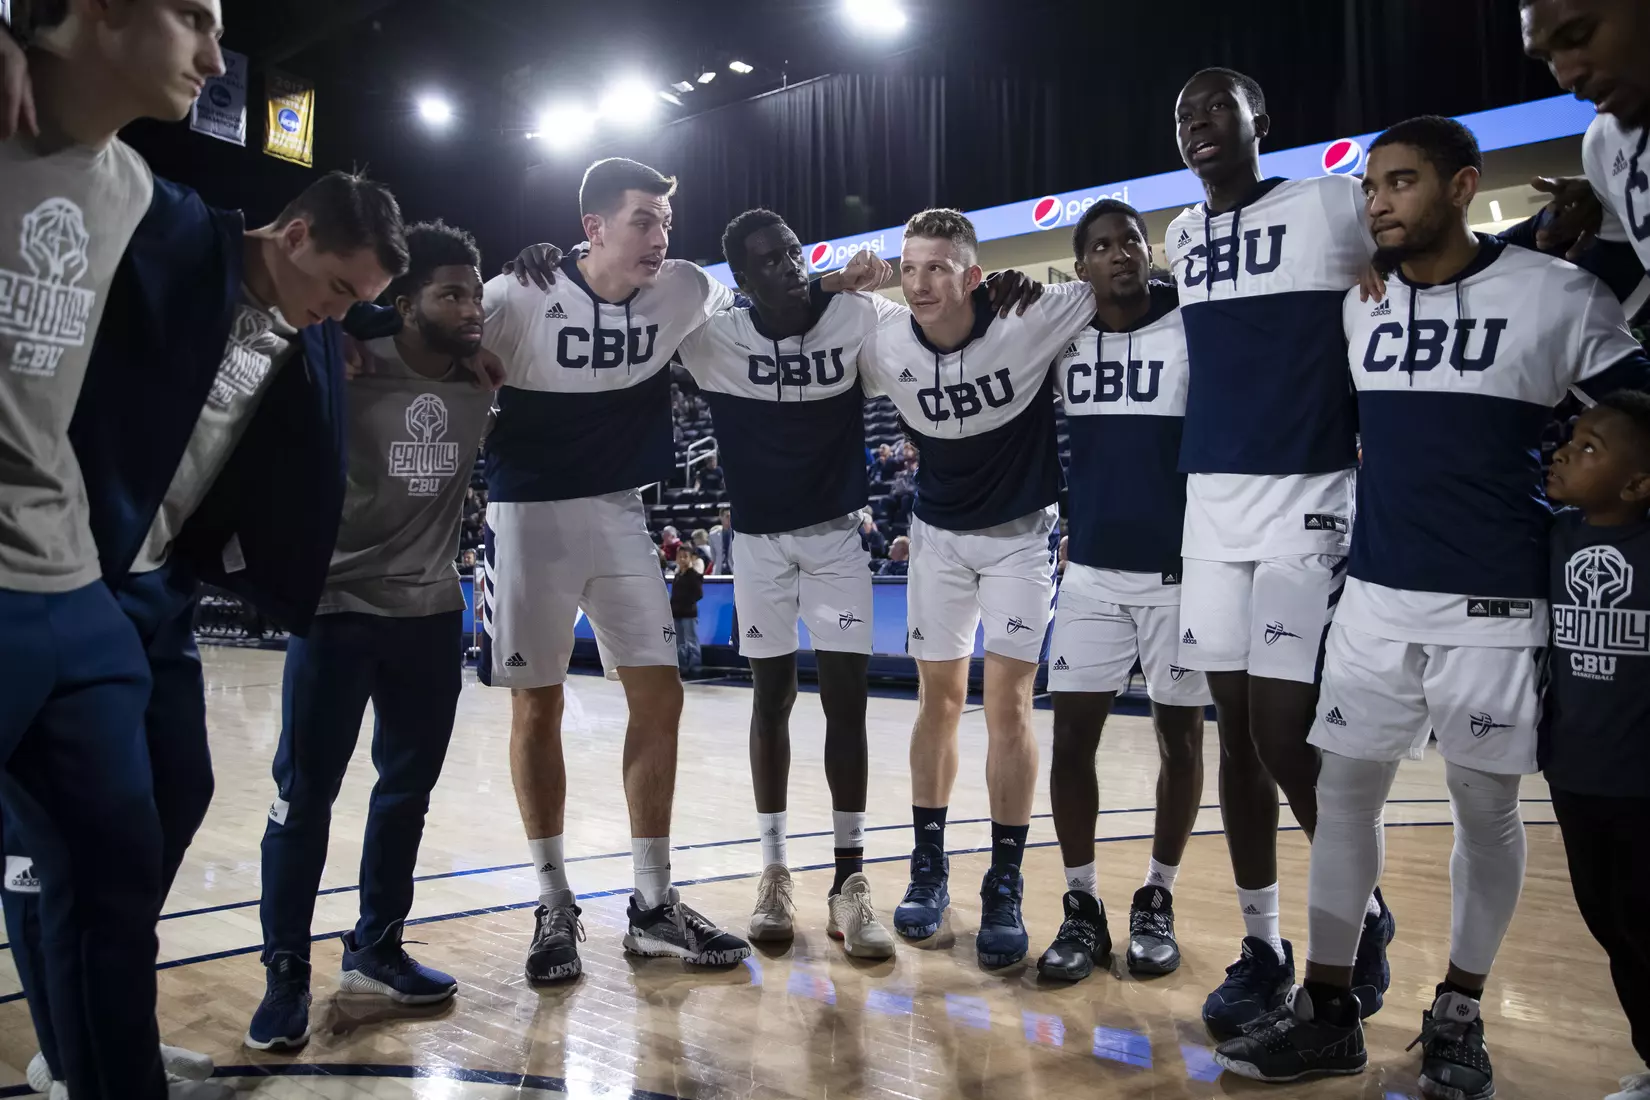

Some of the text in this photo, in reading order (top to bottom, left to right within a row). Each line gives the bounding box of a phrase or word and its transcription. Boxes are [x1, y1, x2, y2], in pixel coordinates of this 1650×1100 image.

[1183, 224, 1286, 288] CBU
[545, 312, 568, 320] adidas
[1371, 309, 1392, 317] adidas
[12, 341, 64, 371] CBU
[556, 324, 658, 369] CBU
[1361, 318, 1508, 373] CBU
[747, 347, 844, 386] CBU
[916, 367, 1014, 422] CBU
[1067, 360, 1164, 404] CBU
[407, 478, 440, 493] CBU
[1570, 652, 1617, 675] CBU
[1572, 670, 1615, 681] BASKETBALL
[1325, 716, 1347, 726] adidas
[12, 878, 40, 887] adida
